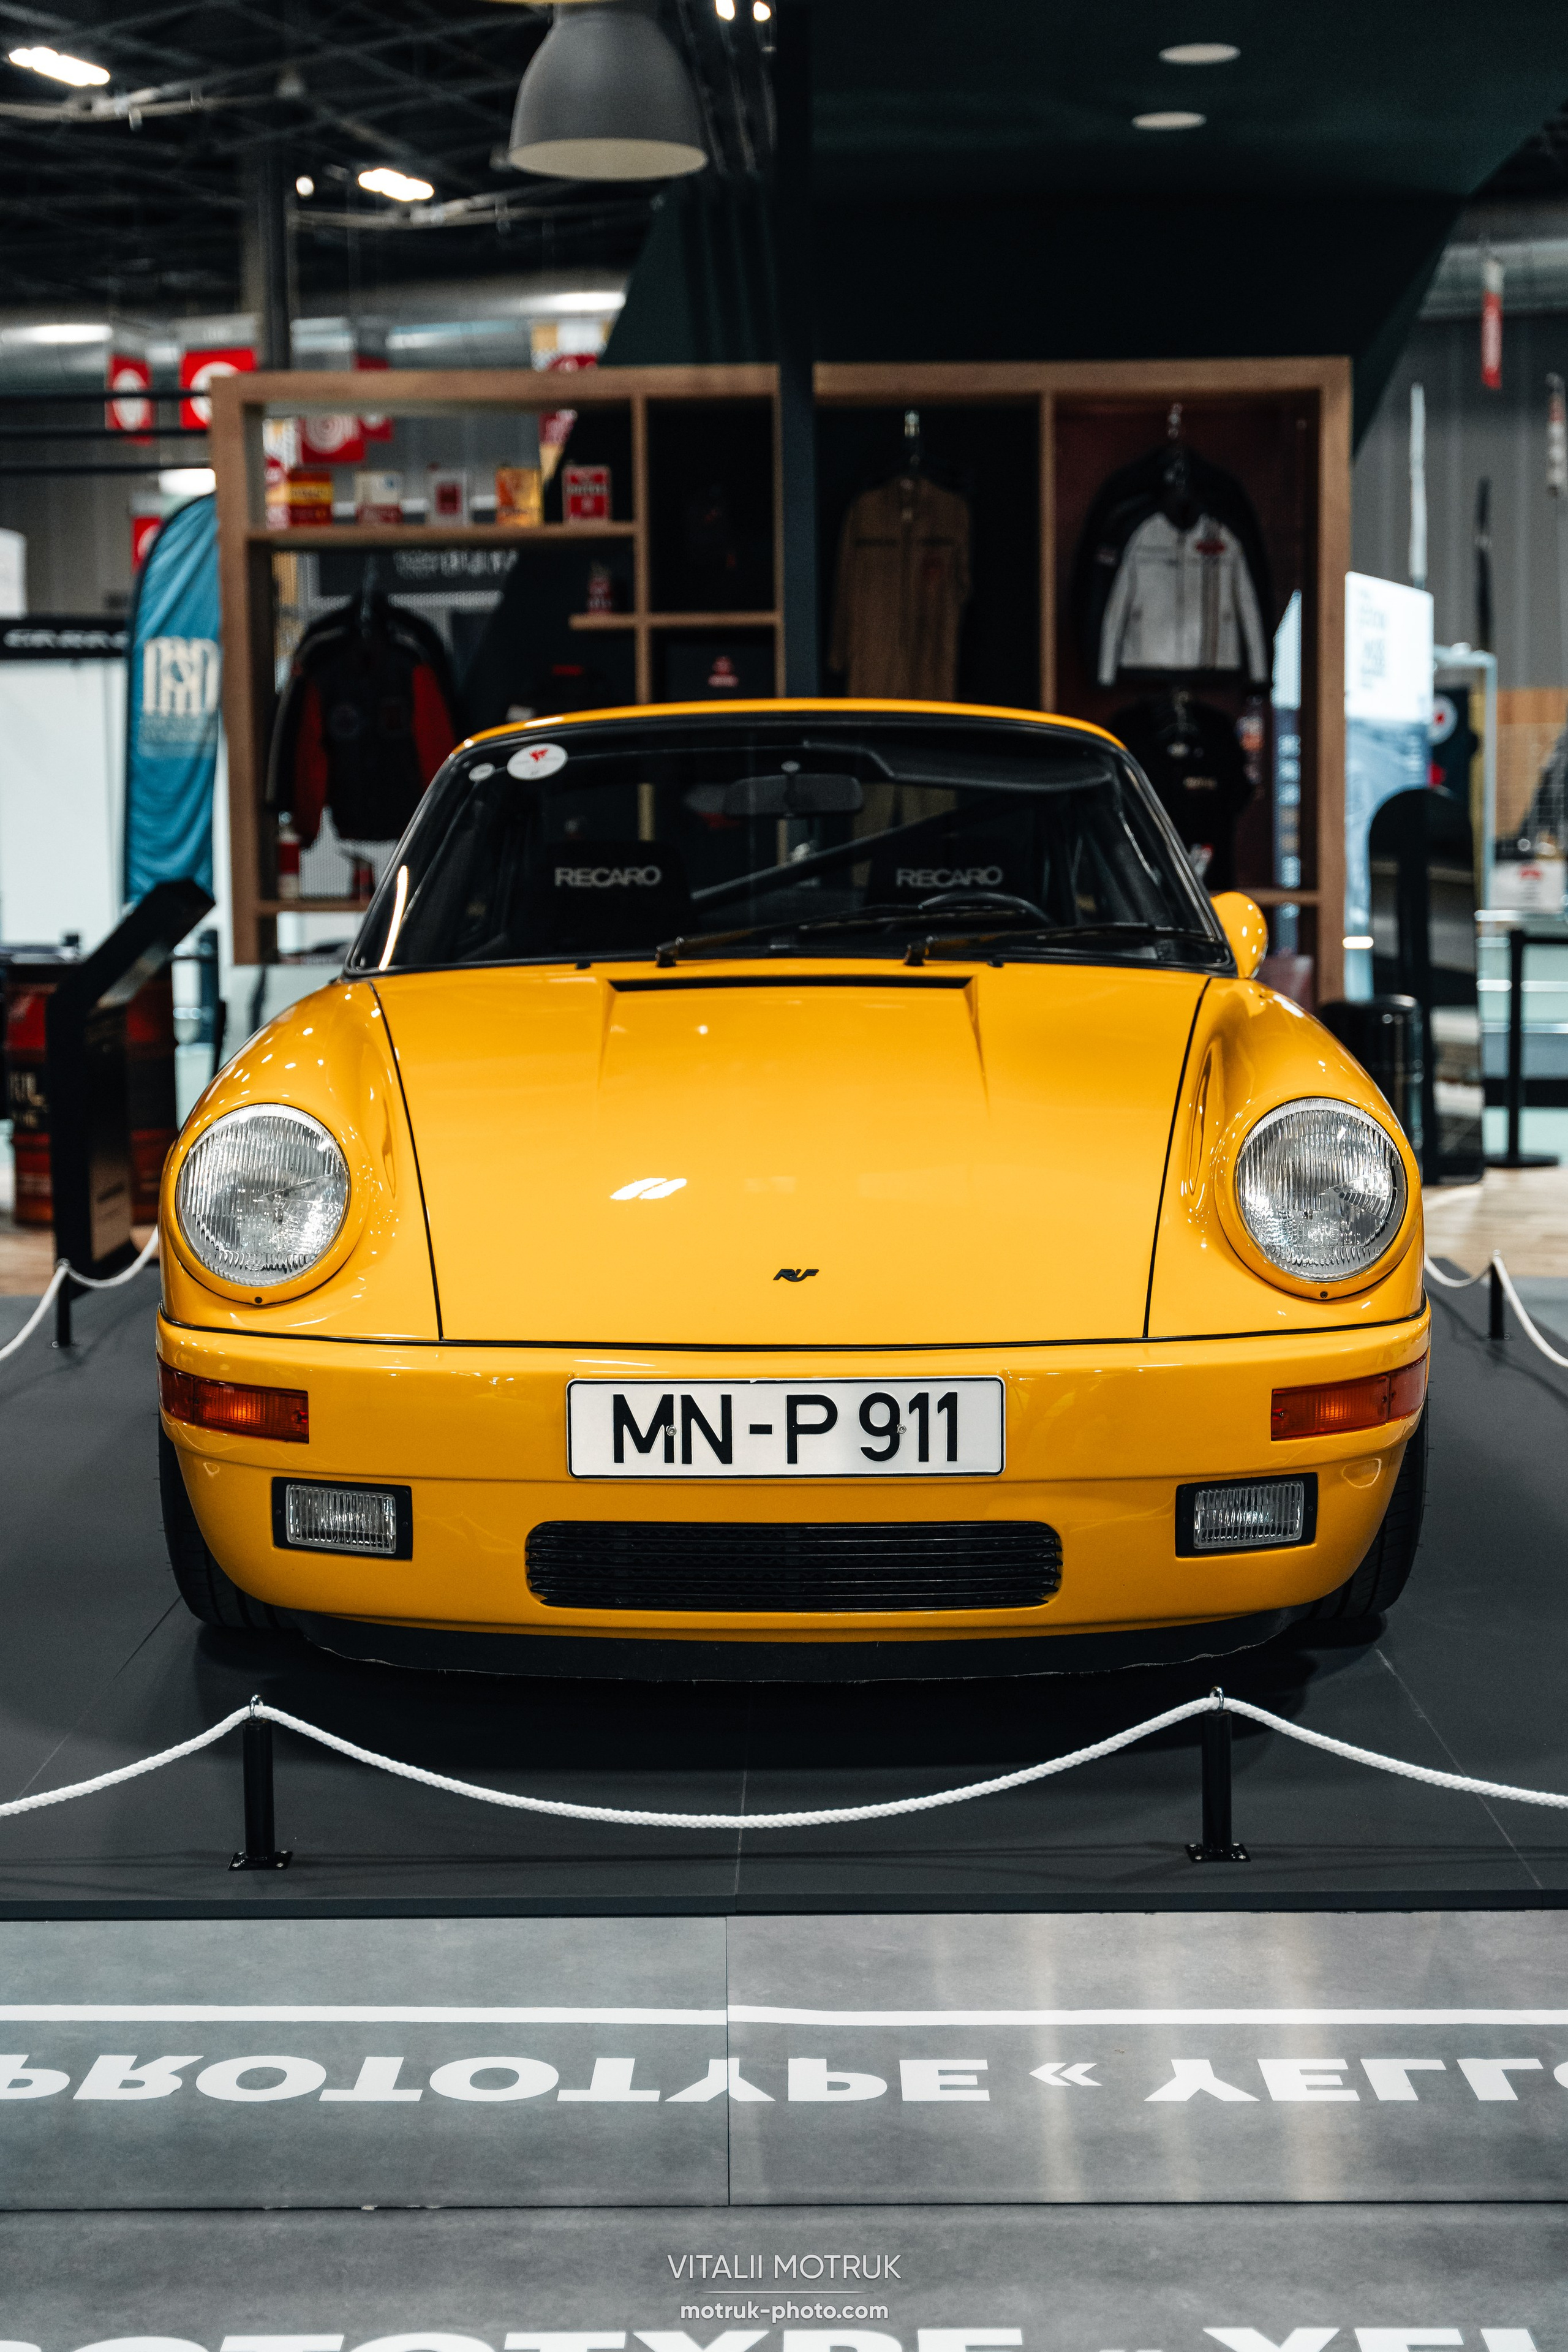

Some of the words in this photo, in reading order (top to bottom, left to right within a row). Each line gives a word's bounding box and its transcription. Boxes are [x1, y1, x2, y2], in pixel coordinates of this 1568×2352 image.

[554, 865, 662, 888] RECARO
[896, 865, 1003, 888] RECARO
[773, 1268, 820, 1283] RUF
[859, 1392, 959, 1463] 911
